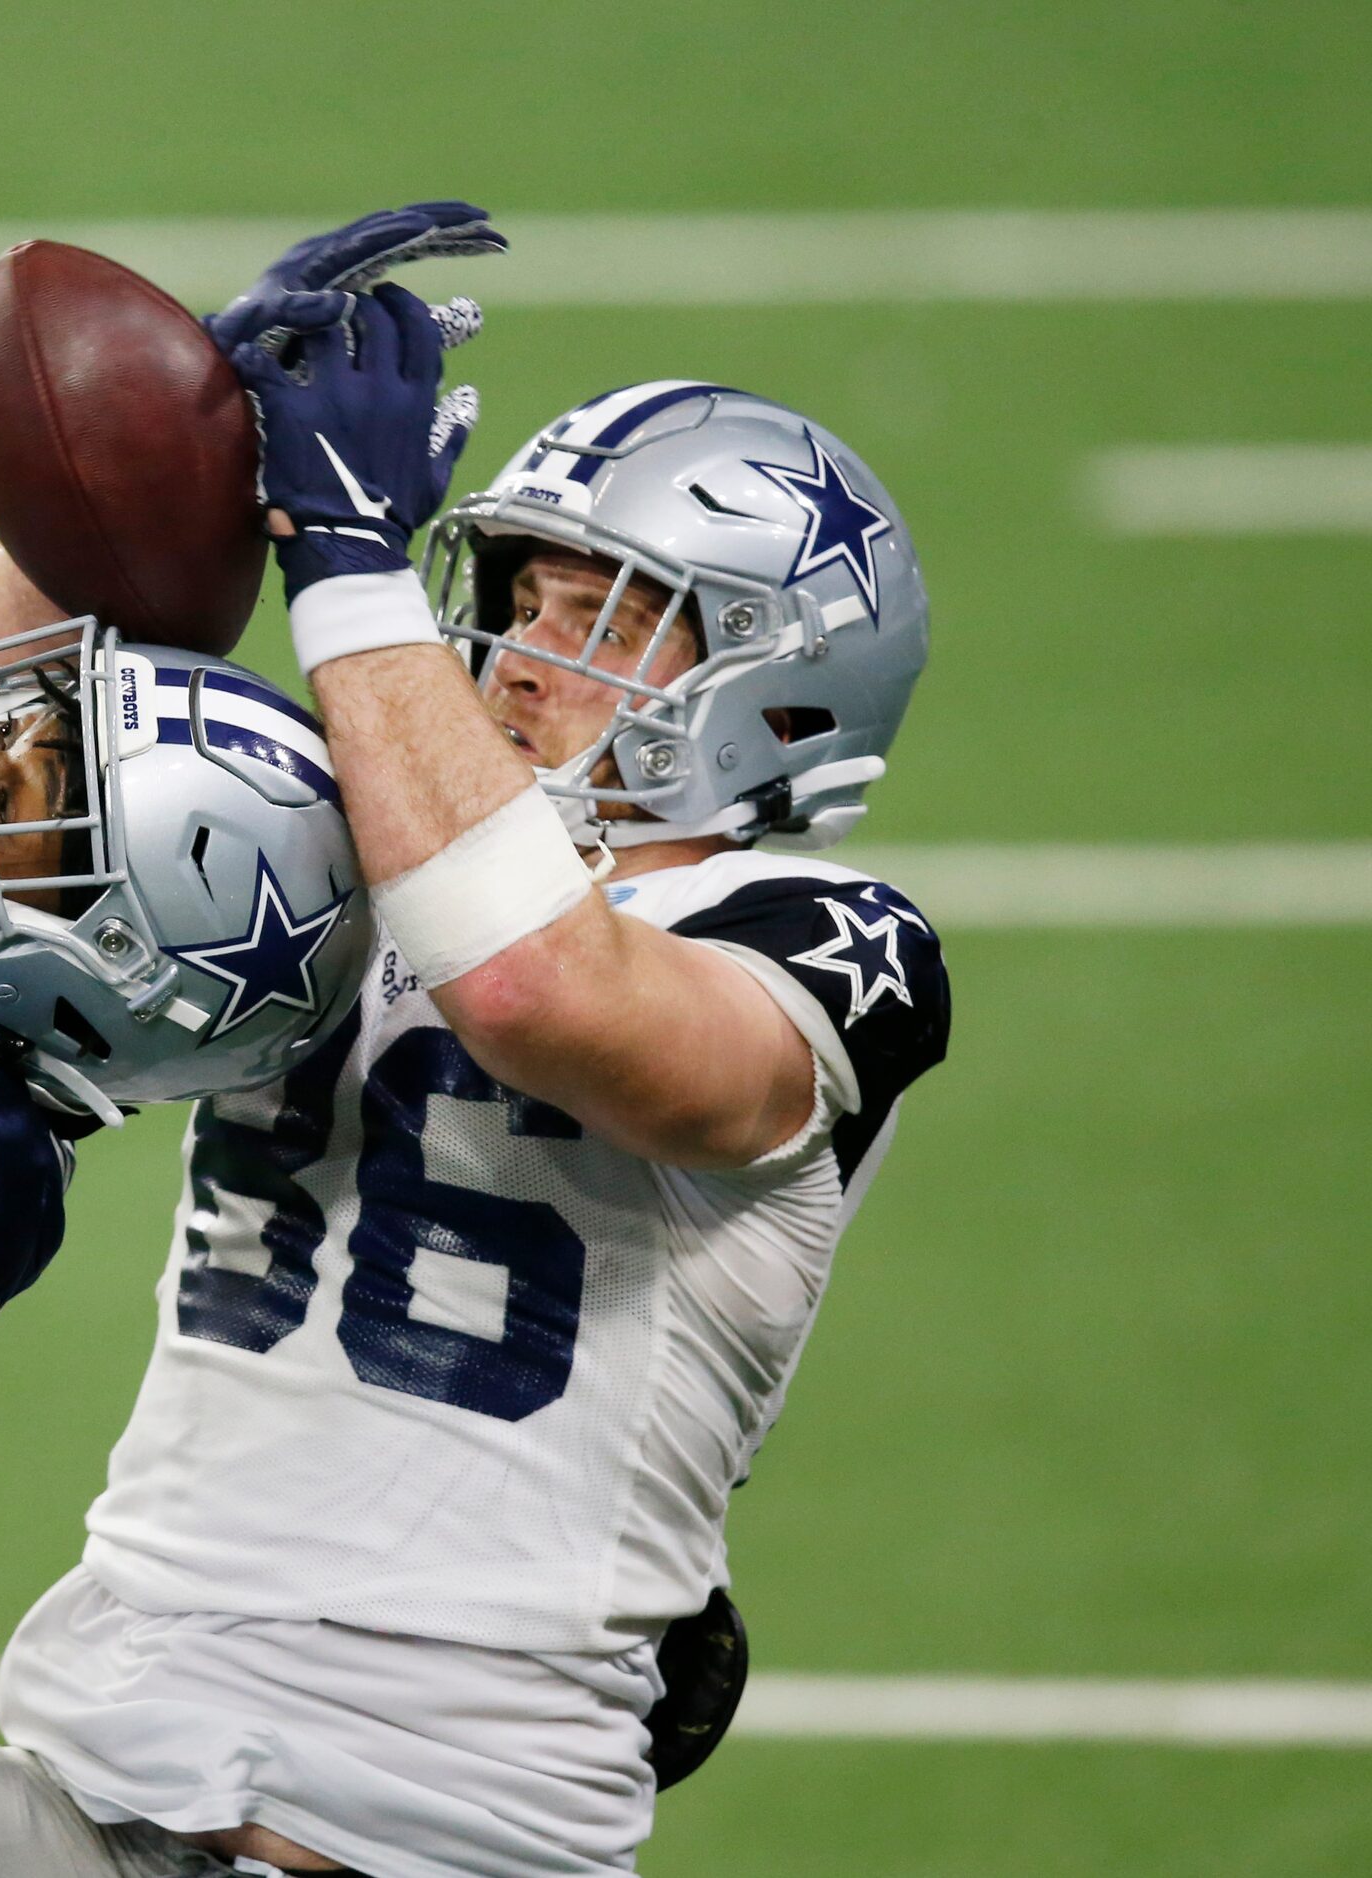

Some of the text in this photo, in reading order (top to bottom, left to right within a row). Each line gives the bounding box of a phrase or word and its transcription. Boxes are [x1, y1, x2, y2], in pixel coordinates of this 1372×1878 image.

[517, 486, 563, 505] BOYS
[120, 667, 140, 731] COWBOYS
[177, 992, 587, 1423] 86
